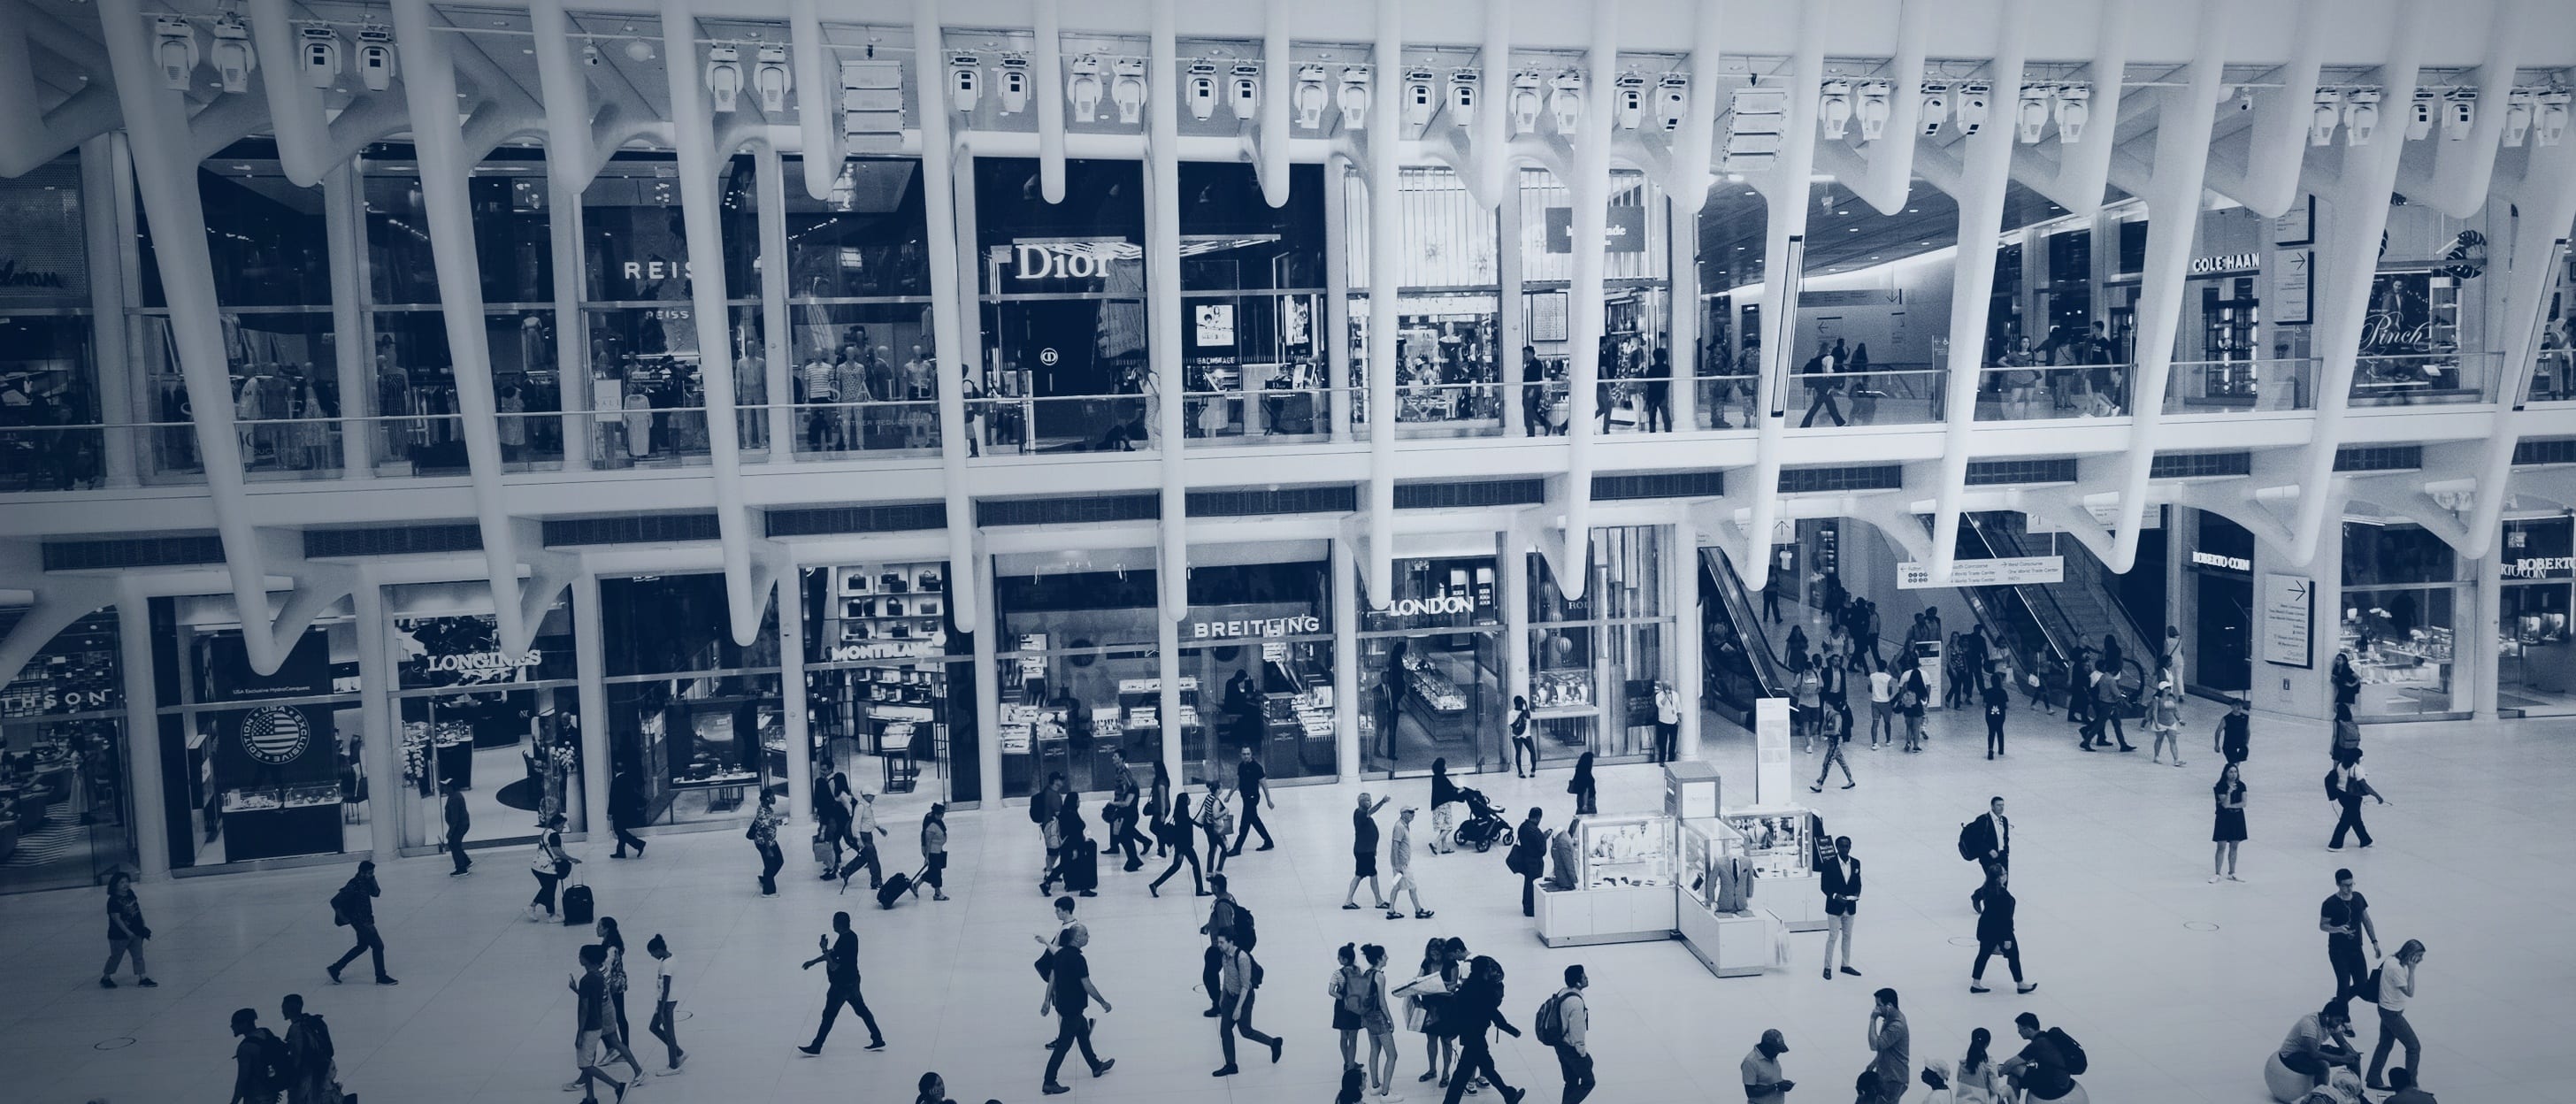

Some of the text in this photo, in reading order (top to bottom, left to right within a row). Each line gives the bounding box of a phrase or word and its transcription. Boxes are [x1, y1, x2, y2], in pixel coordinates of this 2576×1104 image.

[624, 261, 694, 280] REIS
[1015, 244, 1109, 279] Dior
[2193, 252, 2260, 272] COLE HAAN
[2358, 310, 2431, 353] Pinch
[827, 378, 932, 402] SALE
[1390, 595, 1475, 617] LONDON
[1194, 617, 1320, 638] BREITLING
[832, 641, 933, 661] MONTBLANC
[243, 717, 263, 758] EDITION
[273, 715, 308, 762] EXCLUSIVE
